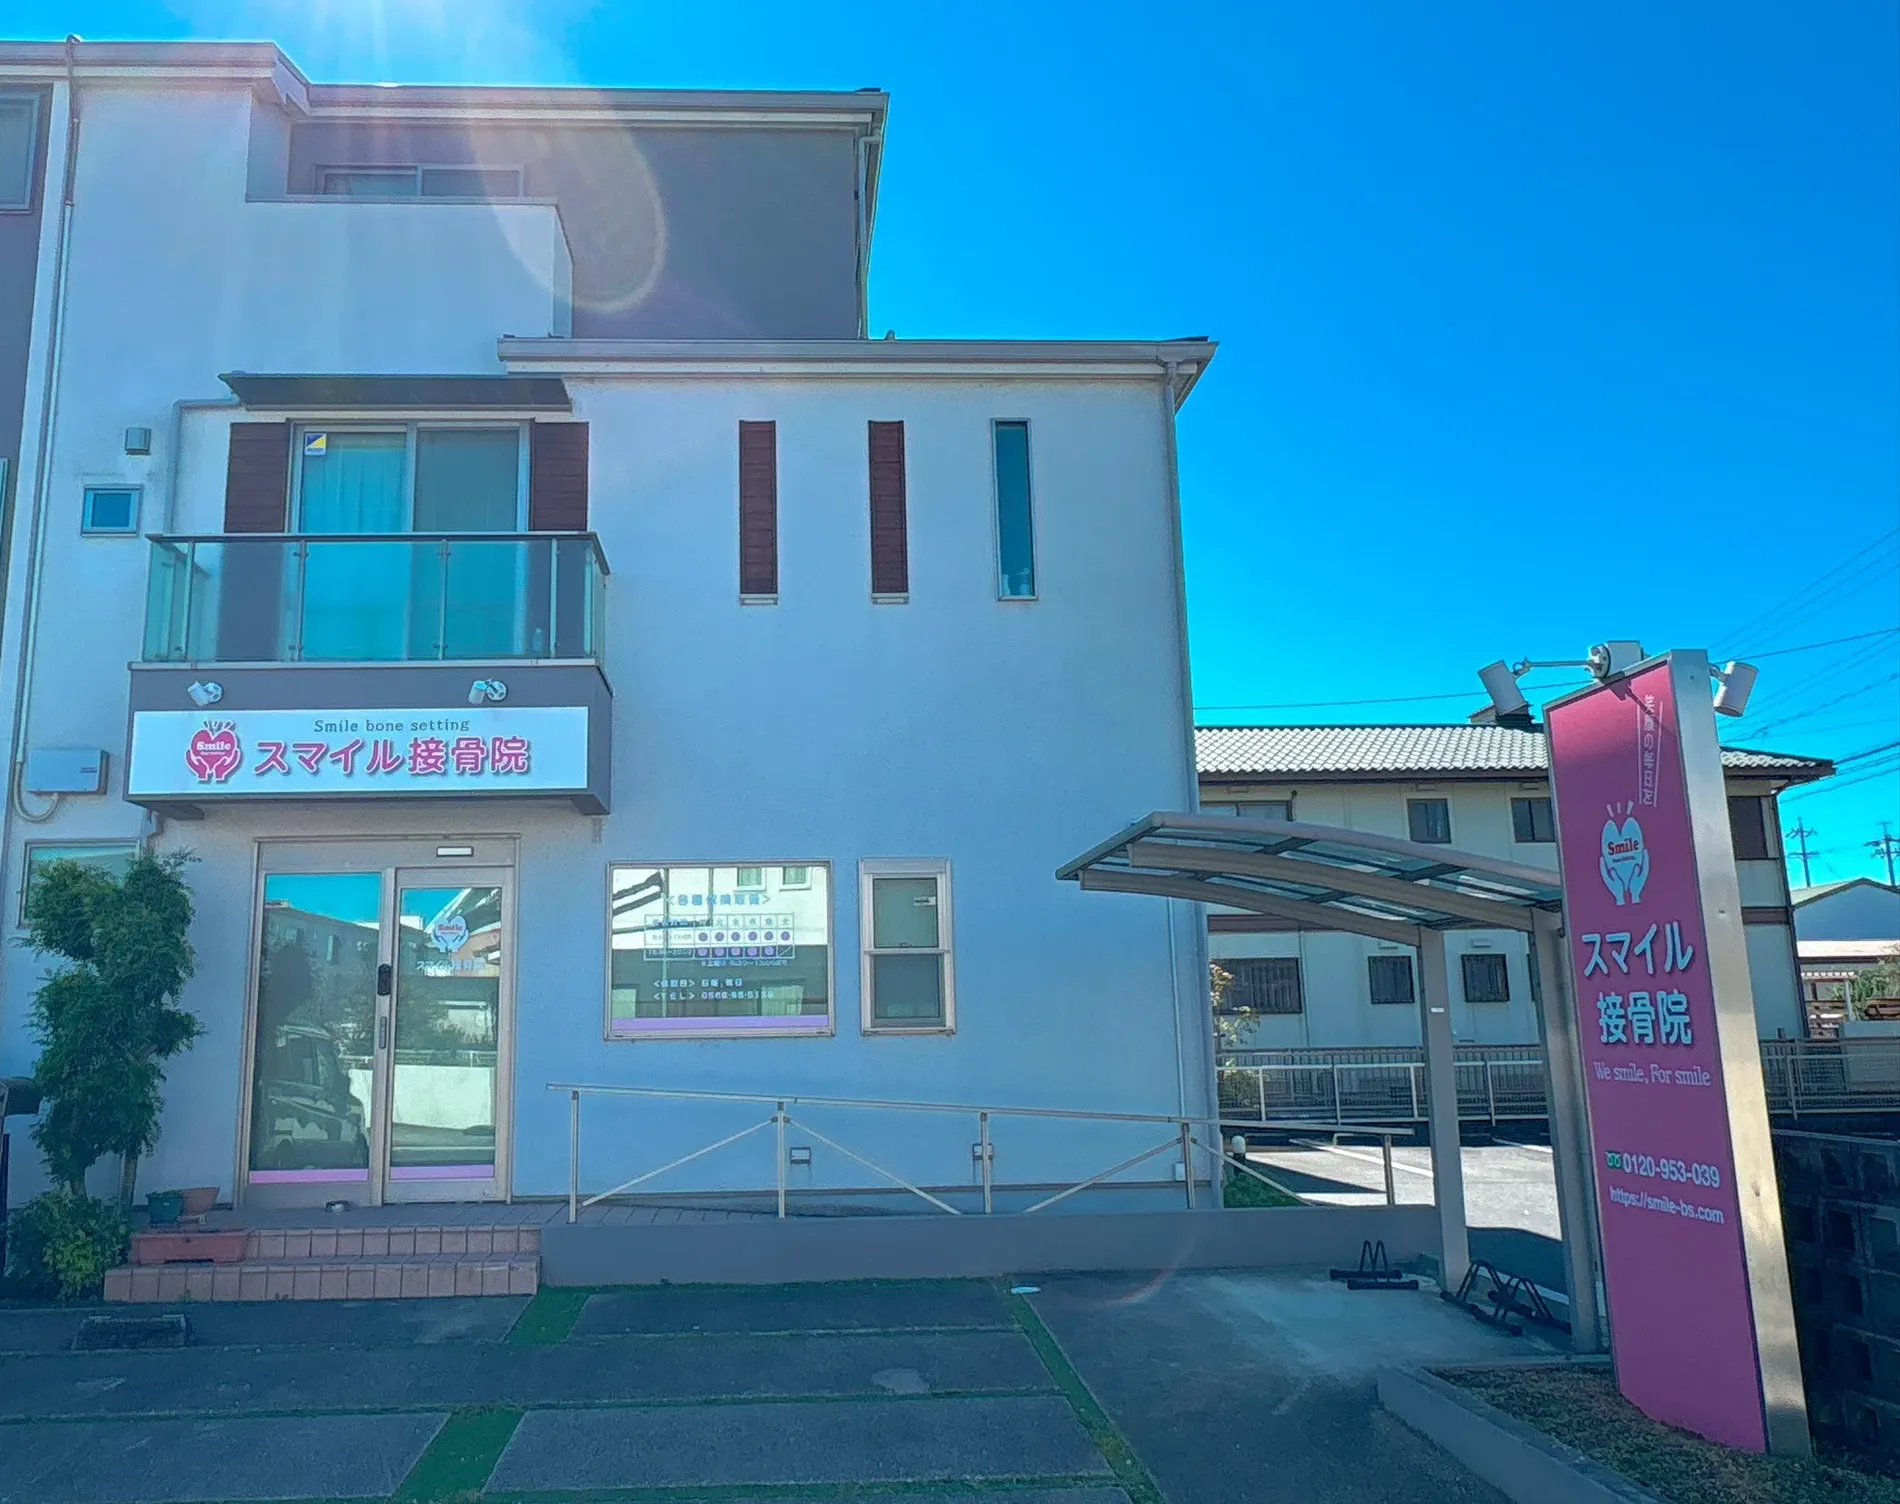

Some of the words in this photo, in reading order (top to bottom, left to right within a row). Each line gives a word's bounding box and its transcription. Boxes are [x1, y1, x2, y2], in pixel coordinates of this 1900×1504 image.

[314, 718, 358, 733] Smile
[366, 718, 404, 733] bone
[411, 718, 470, 734] setting
[254, 735, 532, 777] スマイル接骨院
[1607, 837, 1640, 856] Smile
[1581, 920, 1694, 977] スマイル
[1597, 988, 1694, 1045] 接骨院
[1593, 1061, 1611, 1081] We
[1651, 1064, 1672, 1084] For
[1676, 1065, 1711, 1087] smile
[1622, 1152, 1721, 1188] 0120-953-039
[1609, 1185, 1725, 1224] https://smile-bs.com
